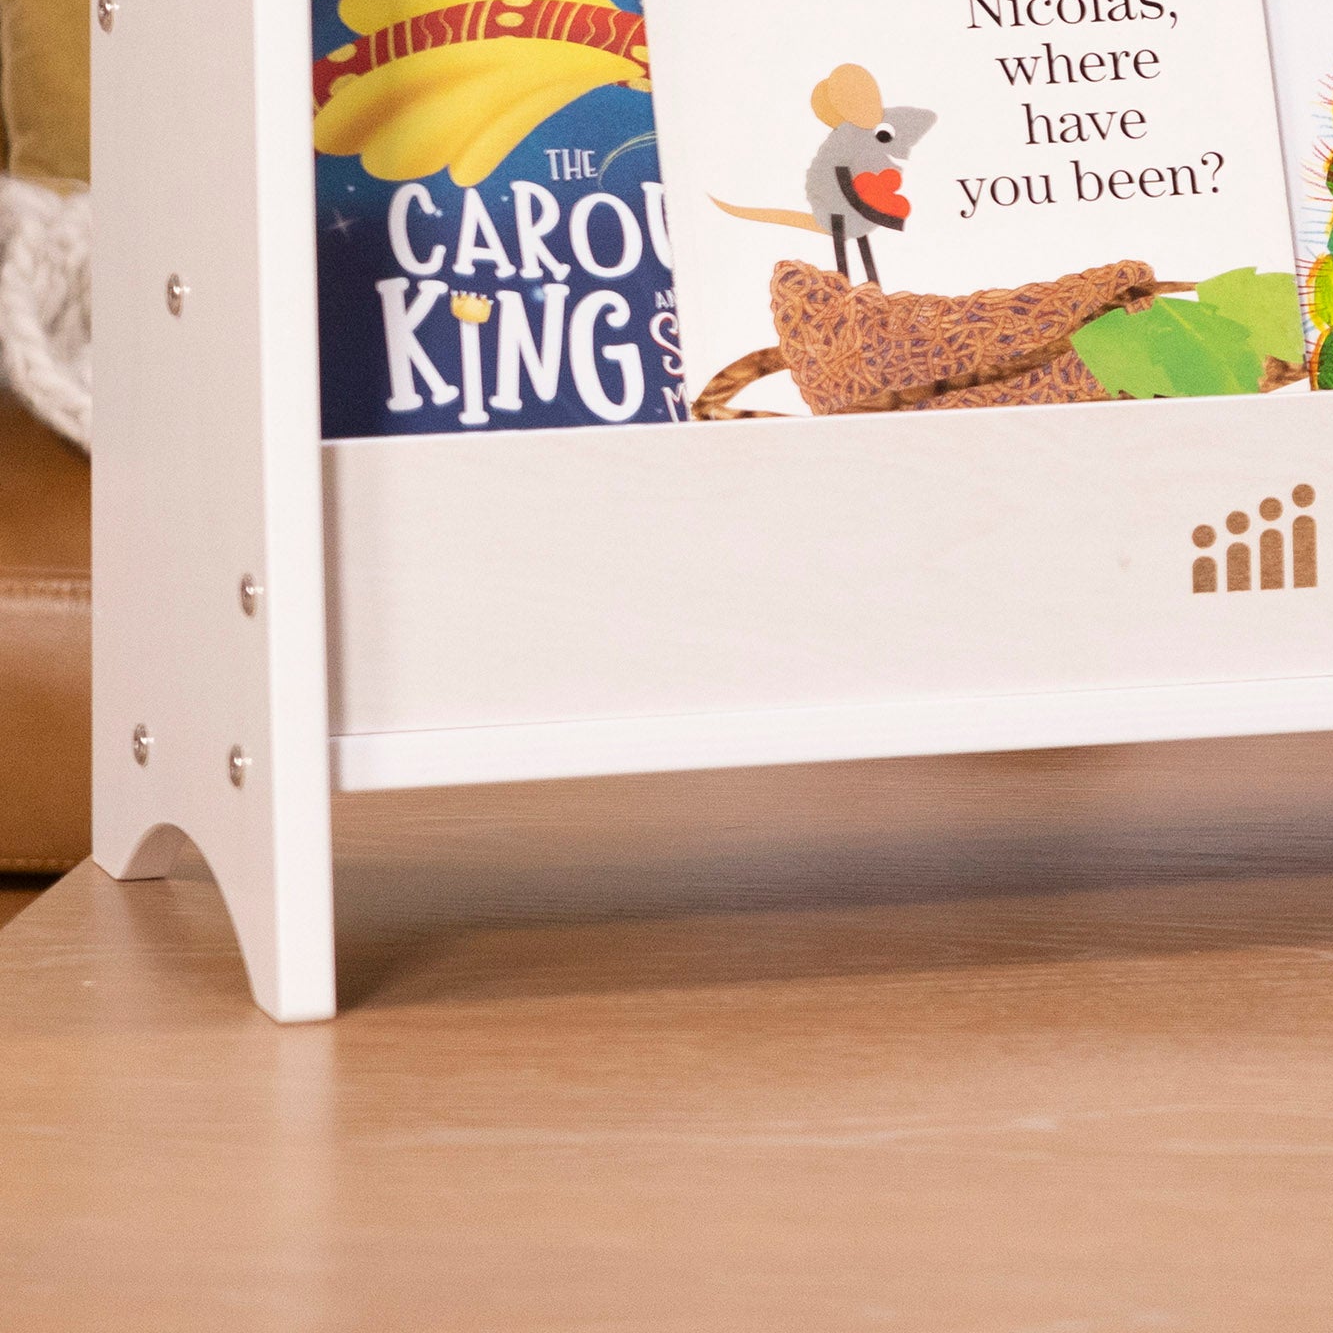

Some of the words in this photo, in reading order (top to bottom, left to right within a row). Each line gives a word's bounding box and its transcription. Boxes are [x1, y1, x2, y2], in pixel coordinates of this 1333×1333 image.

[995, 42, 1162, 86] where
[1021, 103, 1147, 146] have
[544, 148, 599, 182] THE
[956, 173, 1057, 220] you
[1069, 151, 1225, 202] been?
[374, 277, 646, 426] KING
